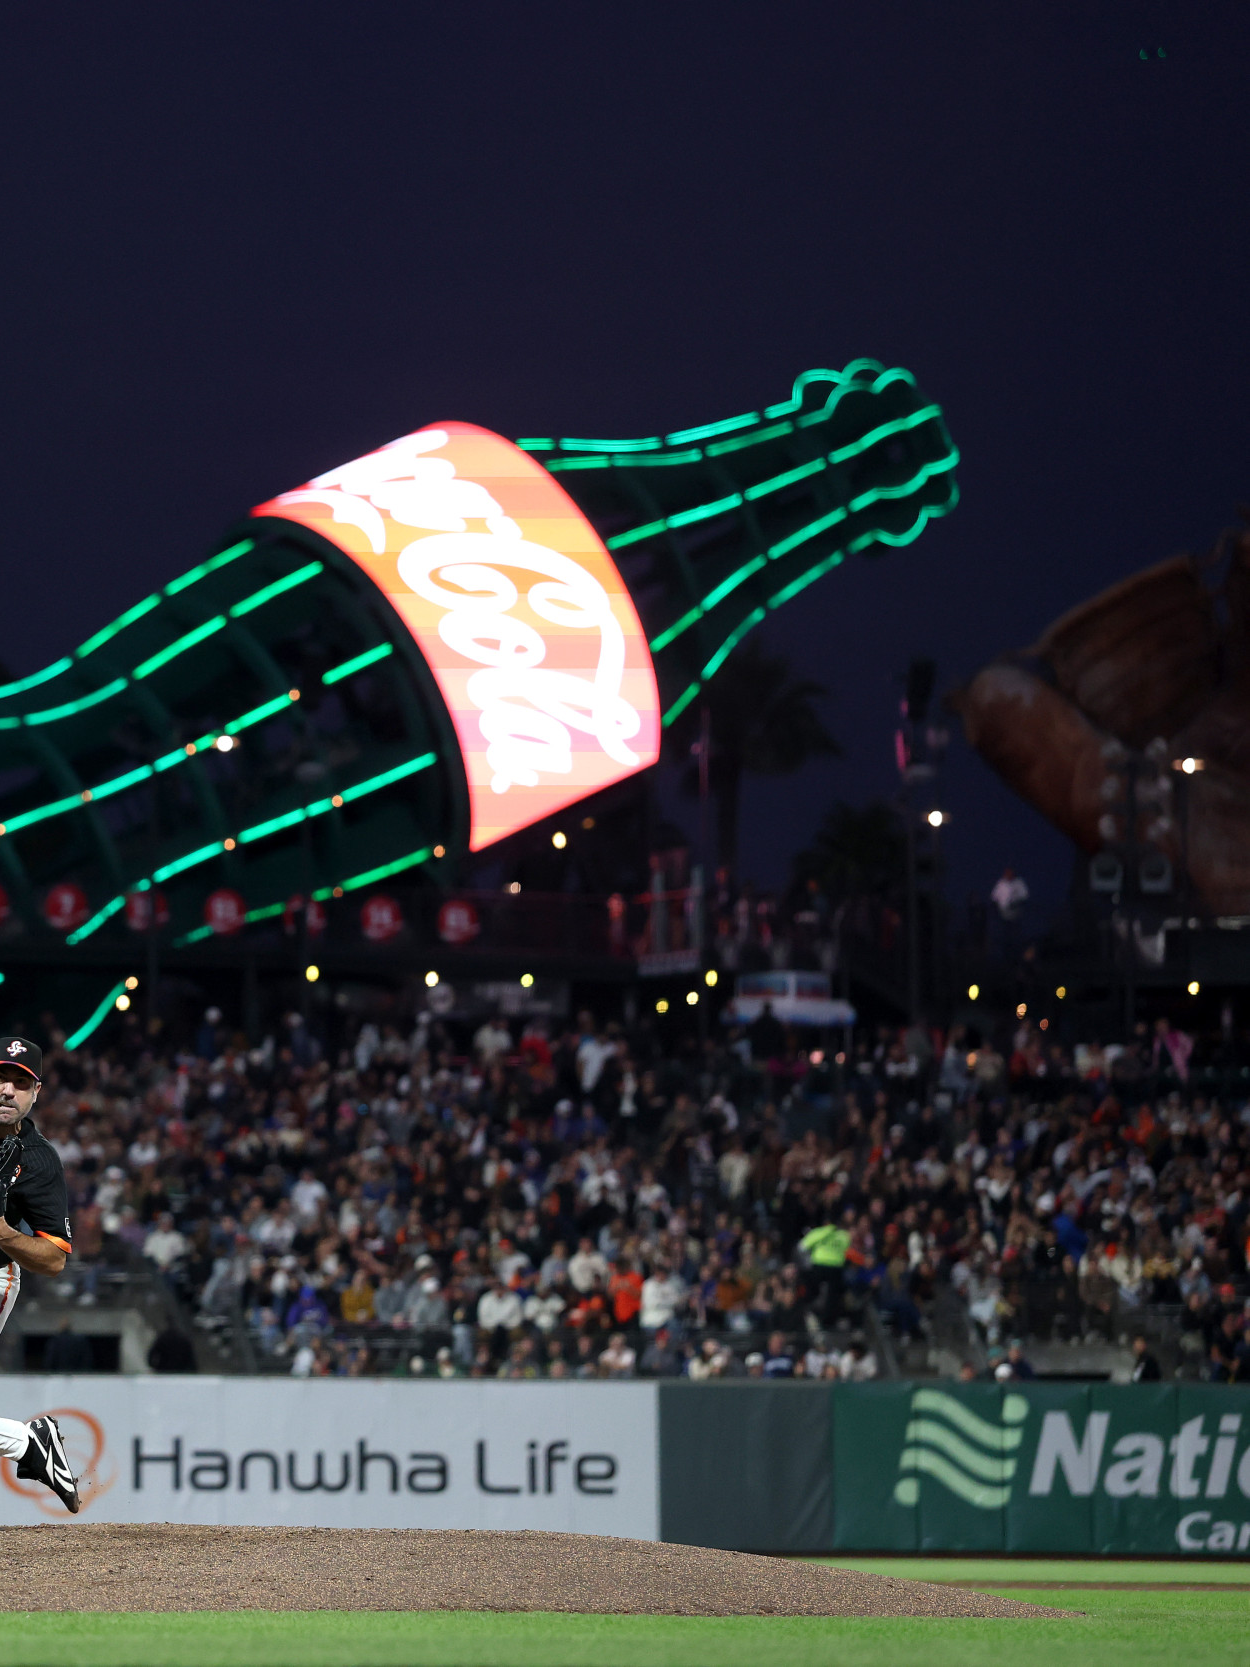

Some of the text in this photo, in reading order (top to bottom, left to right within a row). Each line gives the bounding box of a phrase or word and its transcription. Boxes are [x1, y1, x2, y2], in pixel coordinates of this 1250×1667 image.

[133, 1437, 618, 1495] Hanwha Life
[1028, 1410, 1250, 1500] Nati
